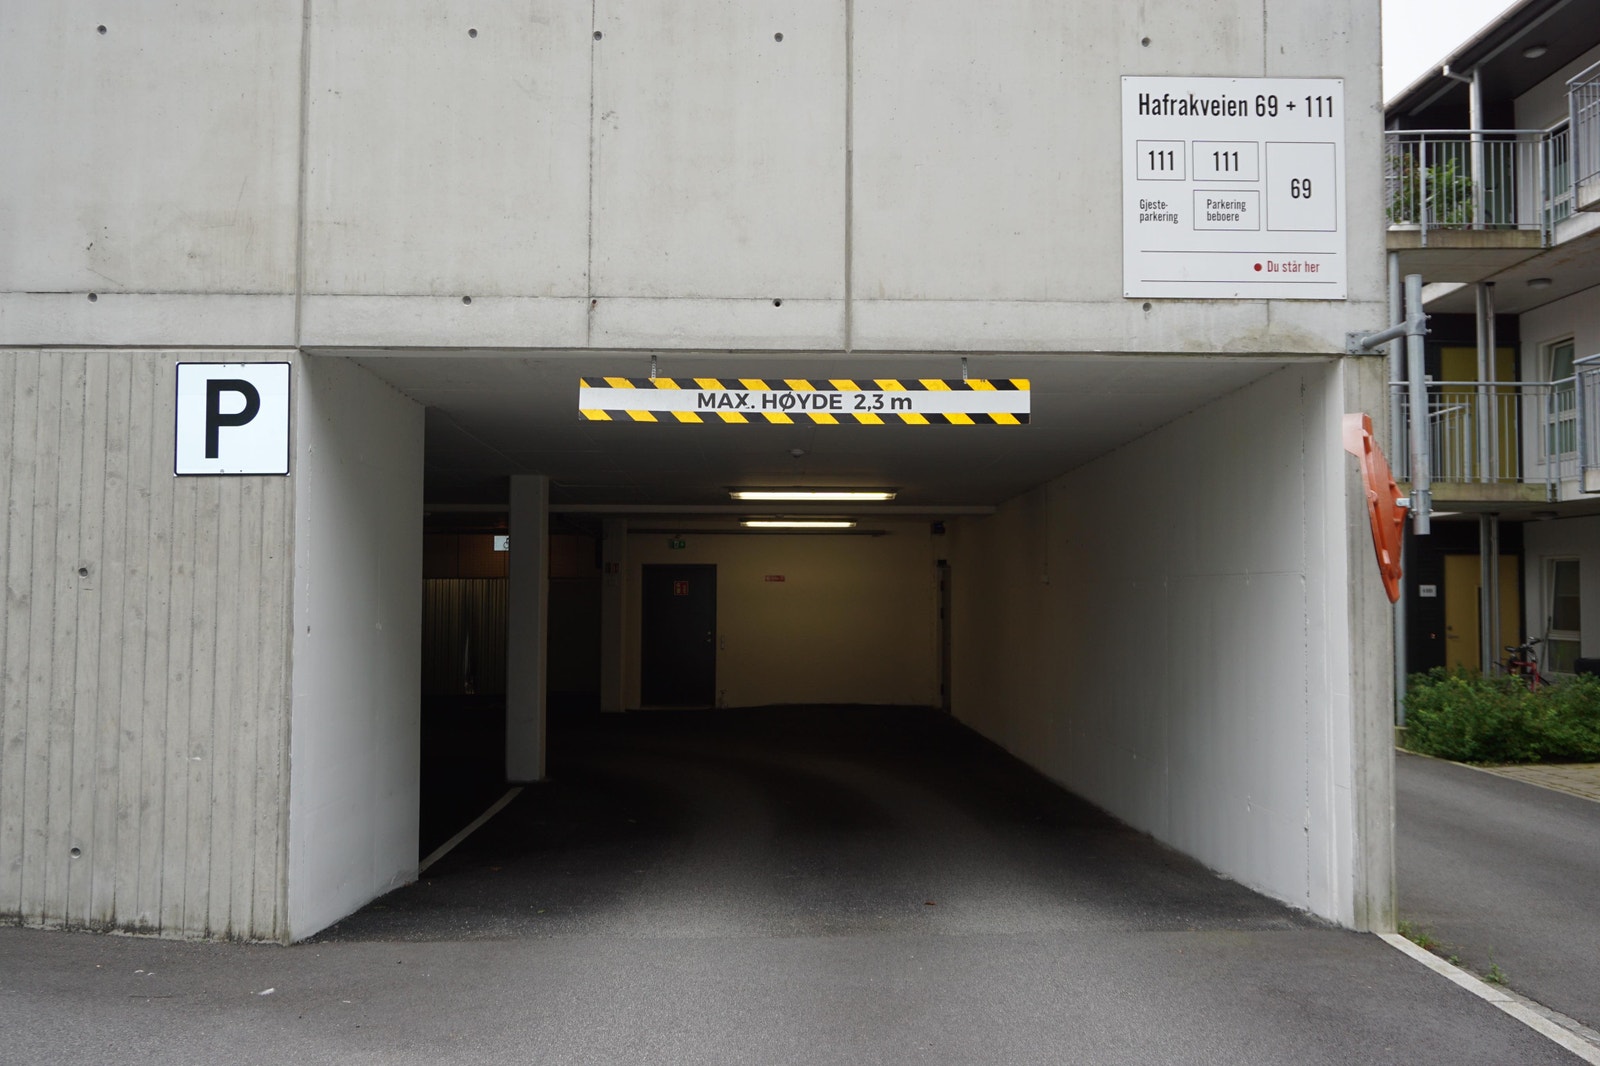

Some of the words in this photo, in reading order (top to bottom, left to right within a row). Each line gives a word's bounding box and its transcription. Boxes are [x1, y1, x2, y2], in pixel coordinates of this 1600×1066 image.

[1138, 93, 1248, 117] Hafrakveien
[1255, 94, 1279, 117] 69
[1286, 101, 1296, 112] +
[1305, 95, 1334, 118] 111
[1148, 150, 1174, 171] 111
[1213, 151, 1239, 172] 111
[1290, 178, 1312, 199] 69
[1139, 199, 1168, 211] Gjeste-
[1206, 199, 1246, 212] Parkering
[1139, 211, 1179, 224] parkering
[1206, 211, 1240, 222] beboere
[1267, 260, 1280, 273] Du
[1282, 260, 1302, 273] står
[1304, 260, 1320, 273] her
[697, 393, 756, 410] MAX.
[761, 392, 842, 412] HØYDE
[854, 394, 884, 412] 2,3
[891, 397, 913, 411] m
[205, 379, 261, 459] P
